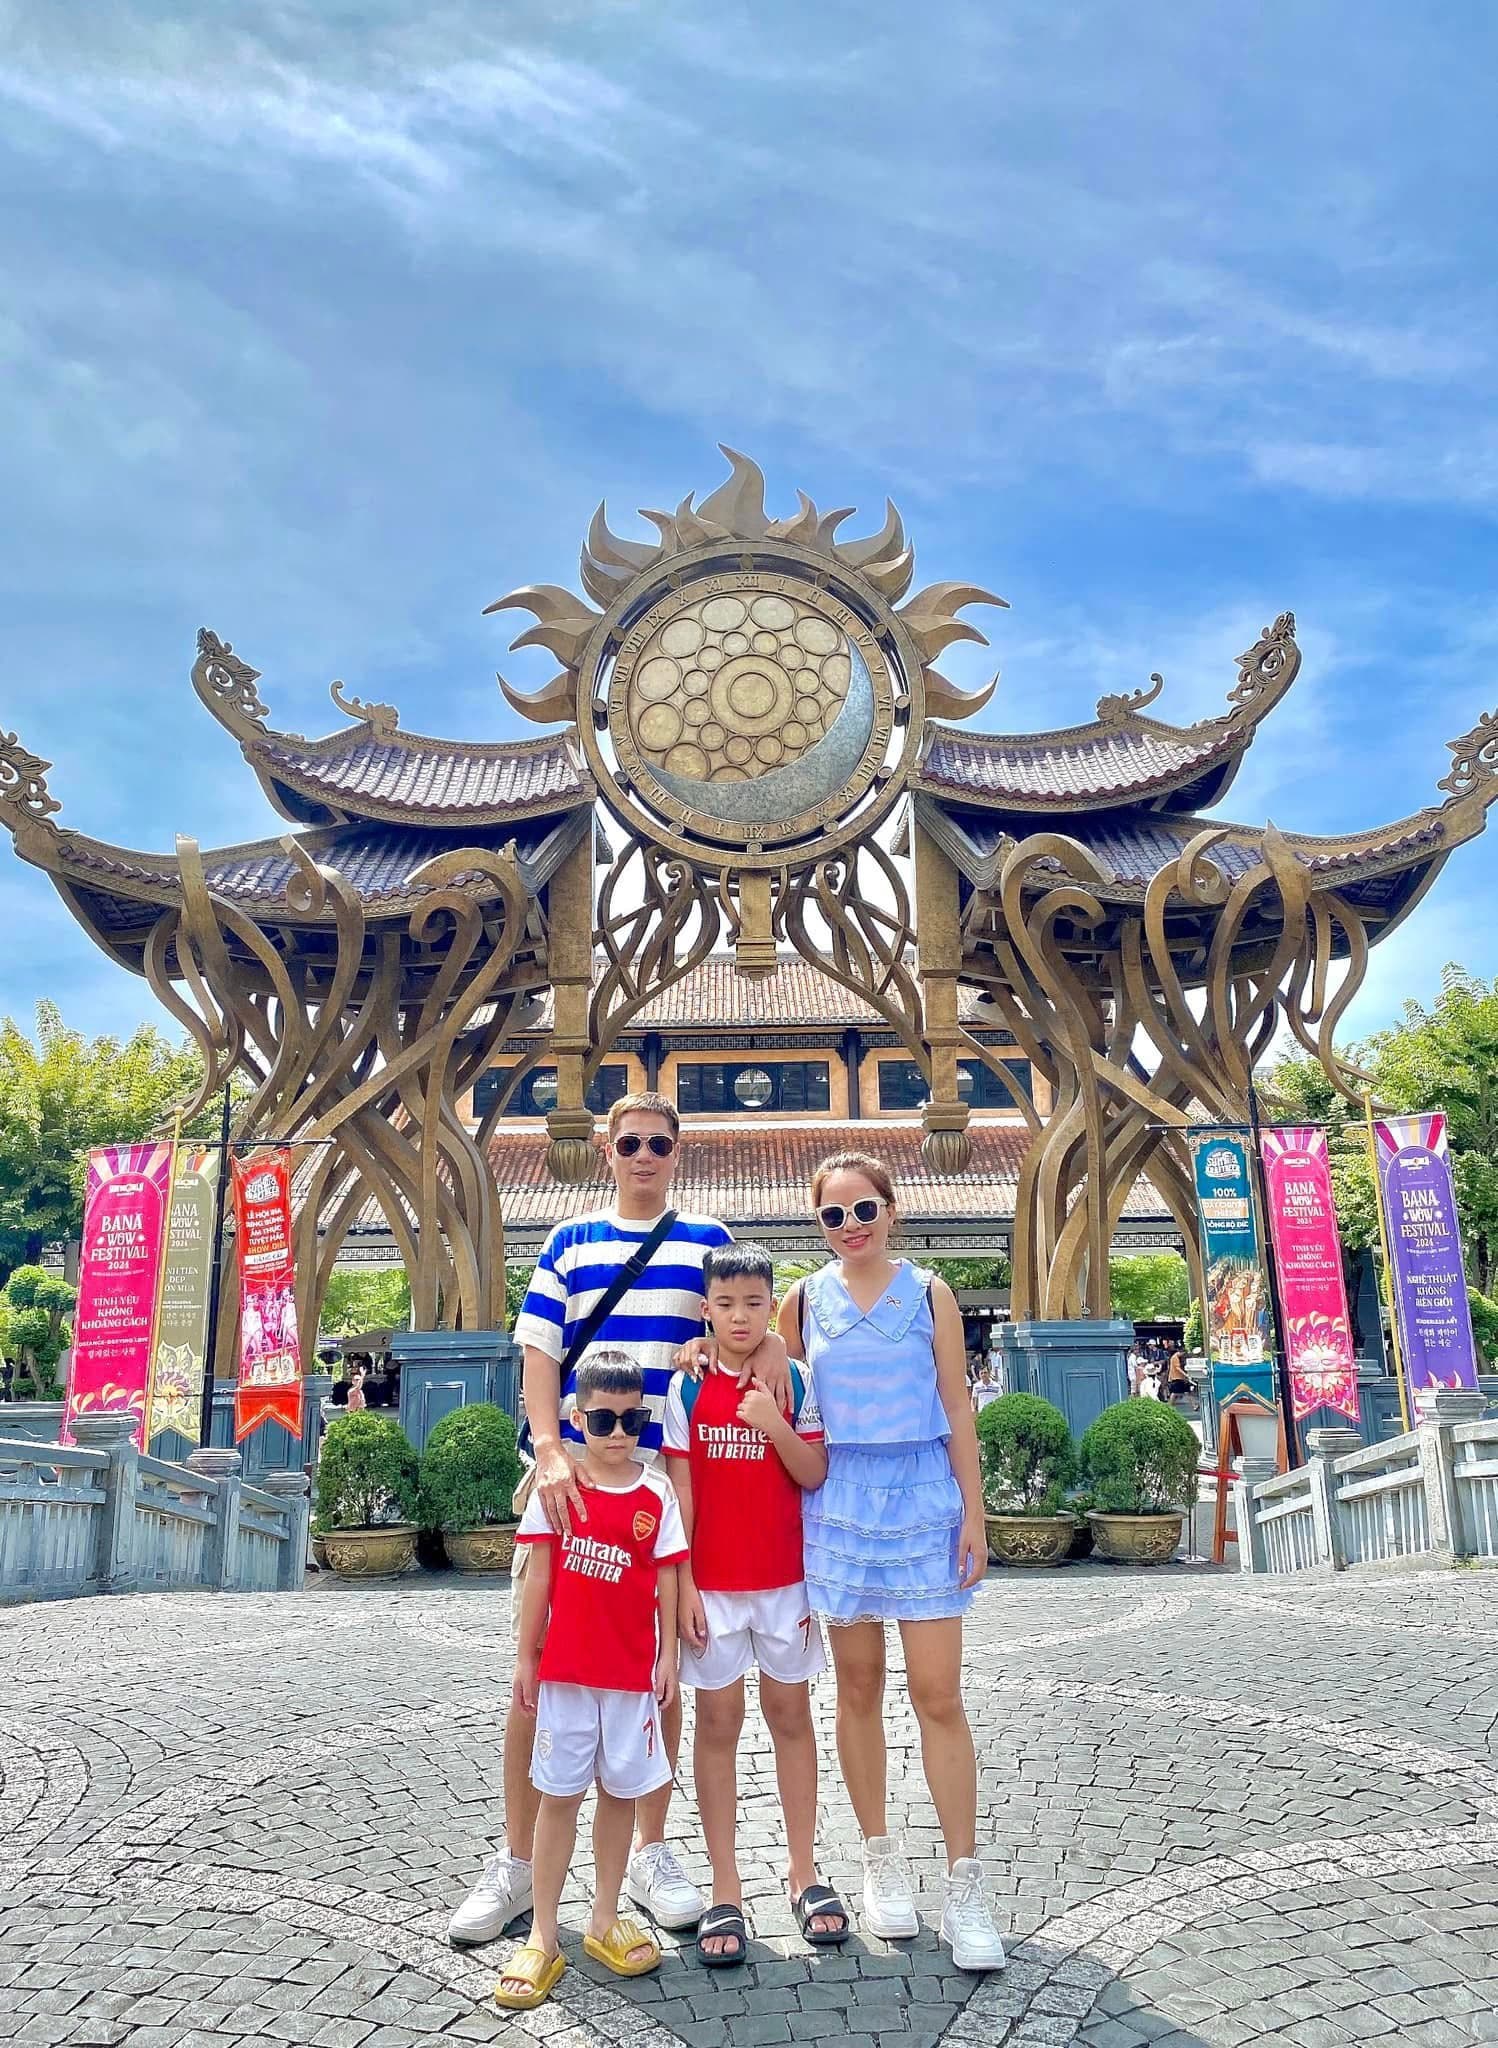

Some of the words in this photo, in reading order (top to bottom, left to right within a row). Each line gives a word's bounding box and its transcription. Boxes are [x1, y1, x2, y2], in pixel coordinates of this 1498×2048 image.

[736, 576, 759, 587] XII
[1212, 1187, 1238, 1198] 100%
[1291, 1195, 1313, 1207] WOW
[171, 1203, 198, 1217] ANA
[1282, 1206, 1325, 1217] FESTIVAL
[1408, 1207, 1433, 1222] WOW
[171, 1217, 193, 1228] WOW
[169, 1229, 201, 1240] STIVAL
[1400, 1222, 1450, 1239] FESTIVAL
[107, 1232, 137, 1247] WOW
[91, 1246, 149, 1262] FESTIVAL
[697, 1424, 775, 1443] Emirate
[707, 1443, 727, 1459] FLY
[725, 1444, 765, 1460] BETTER
[561, 1531, 631, 1567] Emirates
[563, 1553, 583, 1573] FLY
[581, 1558, 622, 1583] BETTER
[796, 1614, 812, 1656] 7
[642, 1716, 655, 1759] 7
